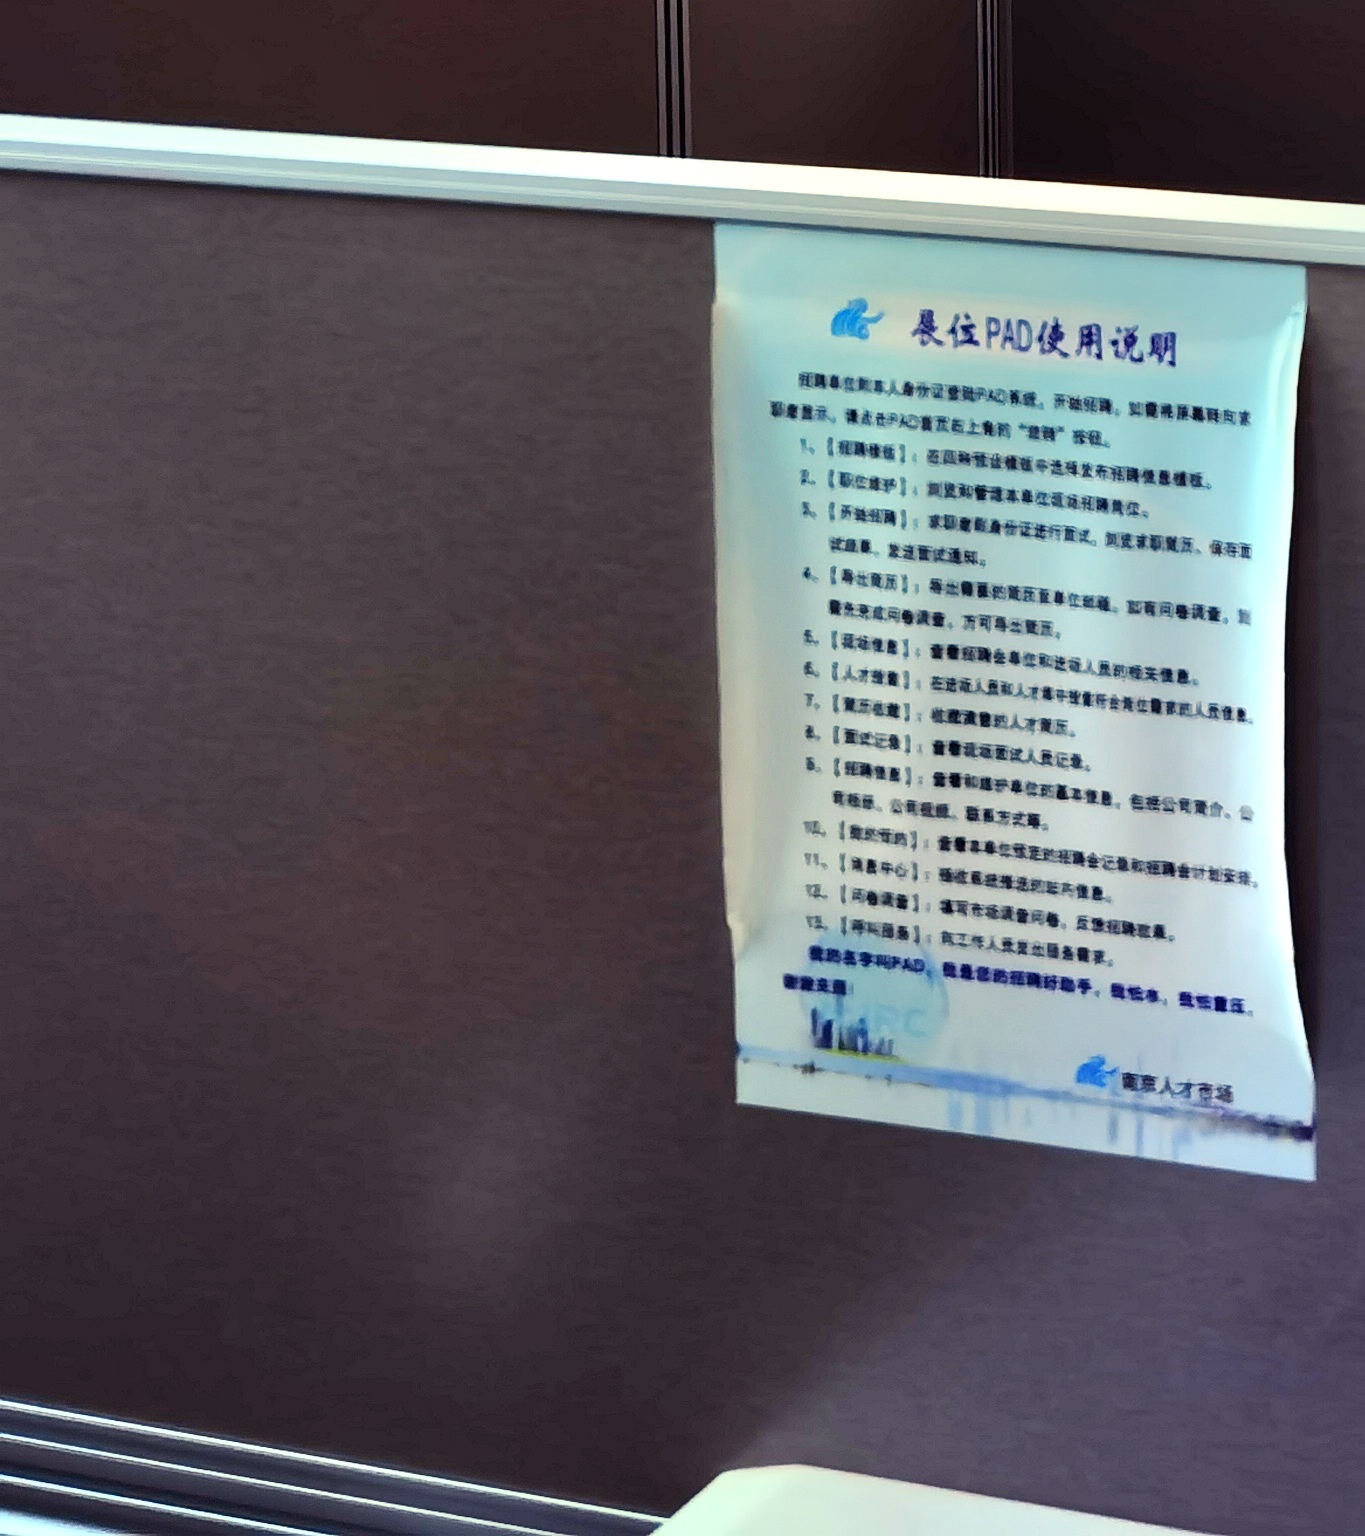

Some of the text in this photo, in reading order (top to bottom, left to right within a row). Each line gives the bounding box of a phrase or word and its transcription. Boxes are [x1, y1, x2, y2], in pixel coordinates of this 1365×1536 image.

[911, 306, 1179, 367] 展位PAD使用说明
